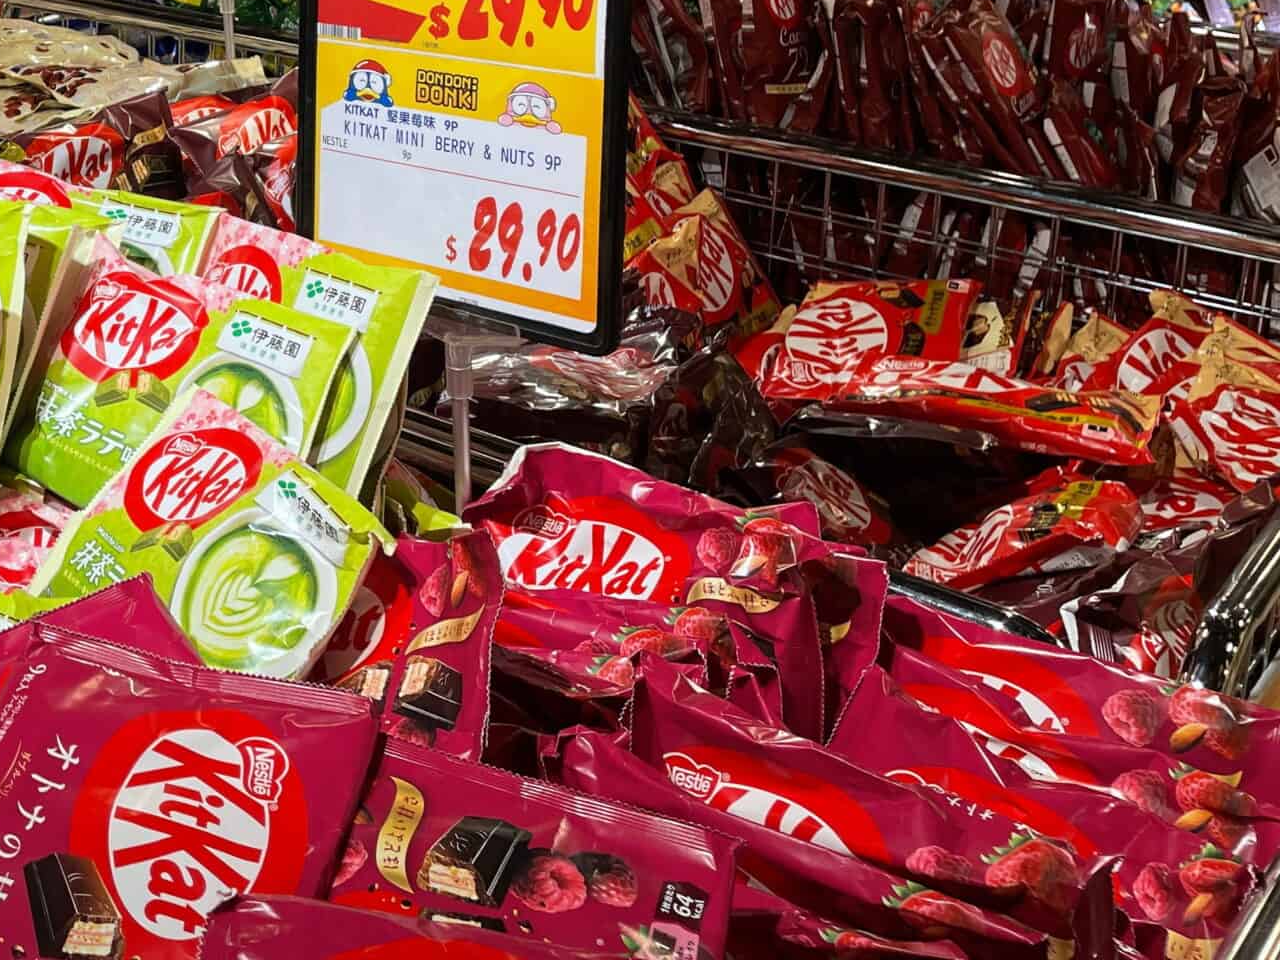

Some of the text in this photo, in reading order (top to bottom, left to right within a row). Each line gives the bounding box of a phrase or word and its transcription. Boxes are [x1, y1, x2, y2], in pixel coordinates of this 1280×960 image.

[416, 83, 478, 111] DONKI
[344, 103, 458, 132] KITKAT 堅果莓味 9P
[322, 135, 412, 161] NESTLE 9p
[344, 120, 562, 172] KITKAT MINI BERRY & NUTS 9P
[128, 213, 174, 235] 伊藤園
[323, 286, 368, 315] 伊藤園
[251, 326, 302, 360] 伊藤園
[143, 448, 246, 520] KitKat
[505, 521, 660, 601] KitKat
[114, 730, 270, 939] KitKat
[673, 891, 692, 918] 64
